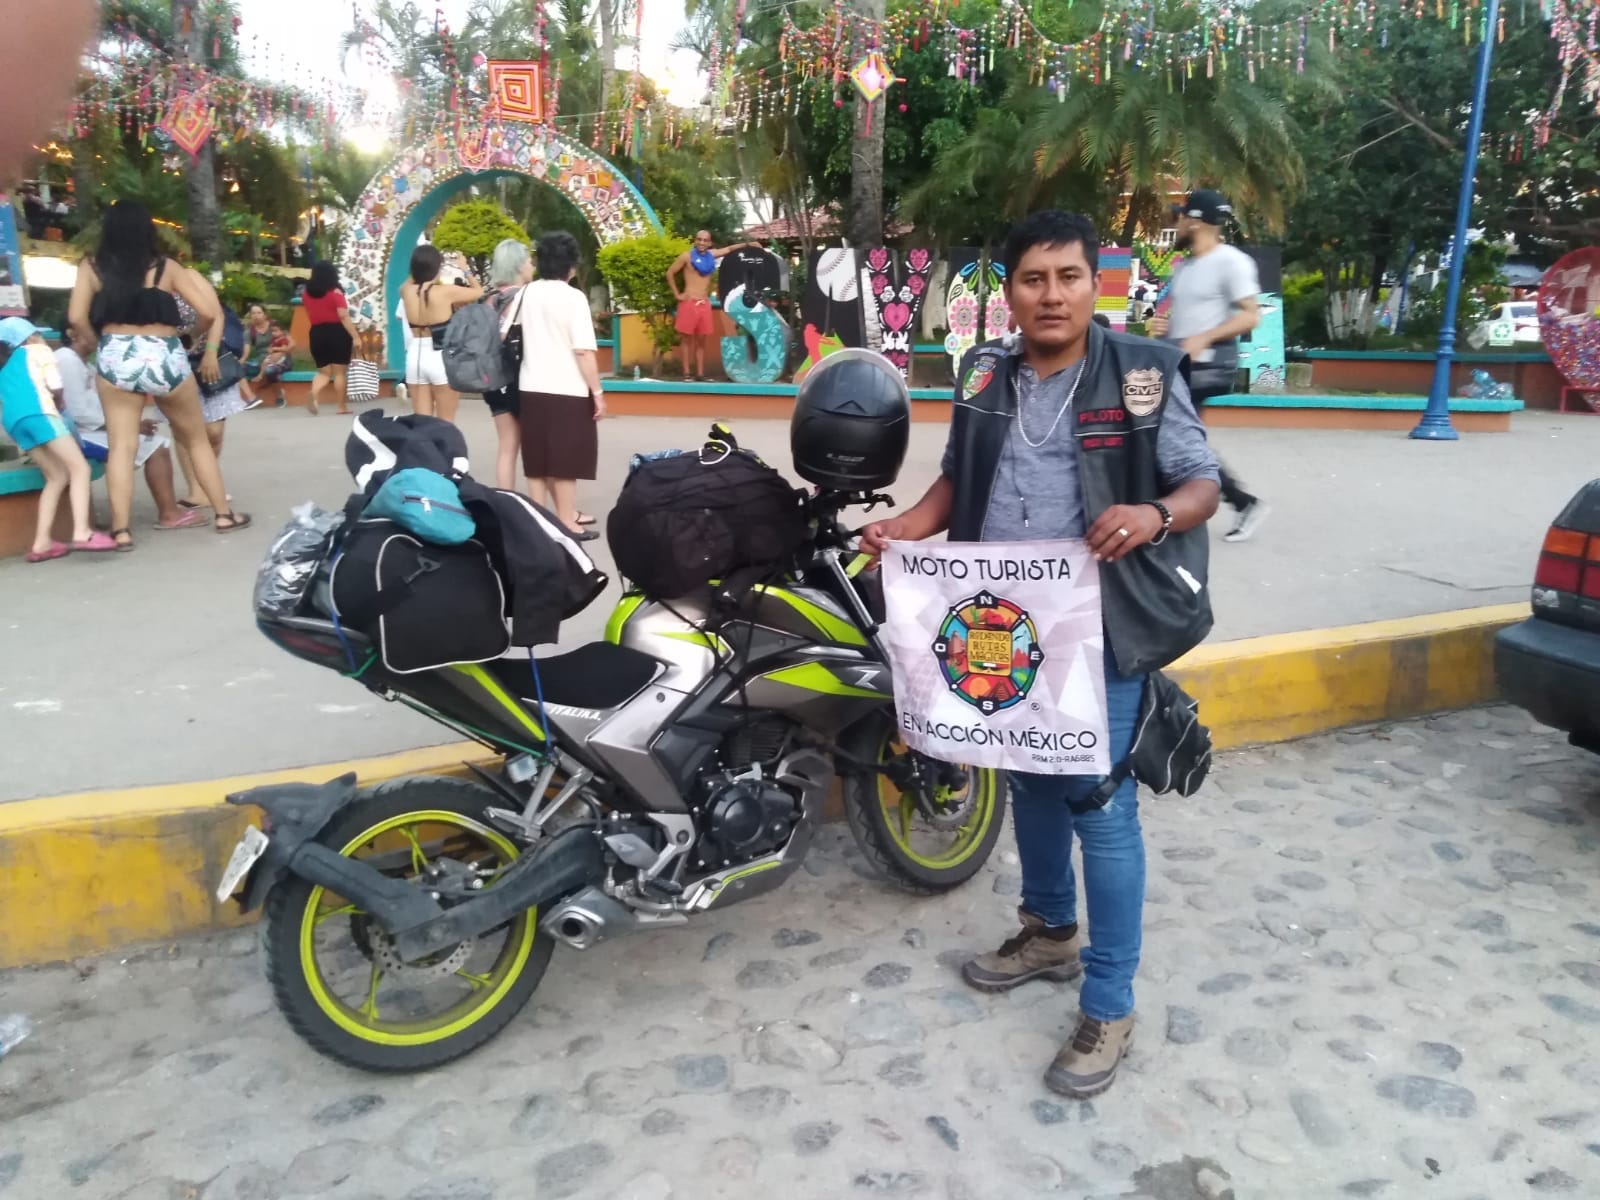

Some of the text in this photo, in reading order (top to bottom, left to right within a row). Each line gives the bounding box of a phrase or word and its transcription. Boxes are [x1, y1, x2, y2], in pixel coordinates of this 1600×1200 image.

[1125, 384, 1160, 396] CIVIL
[1079, 409, 1124, 424] PILOTO
[902, 554, 1071, 581] MOTO TURISTA
[980, 595, 993, 605] N
[934, 643, 946, 653] O
[973, 641, 1007, 652] RUTAS
[1030, 651, 1040, 660] E
[982, 701, 993, 710] S
[903, 711, 1097, 751] EN ACCIÓN MÉXICO
